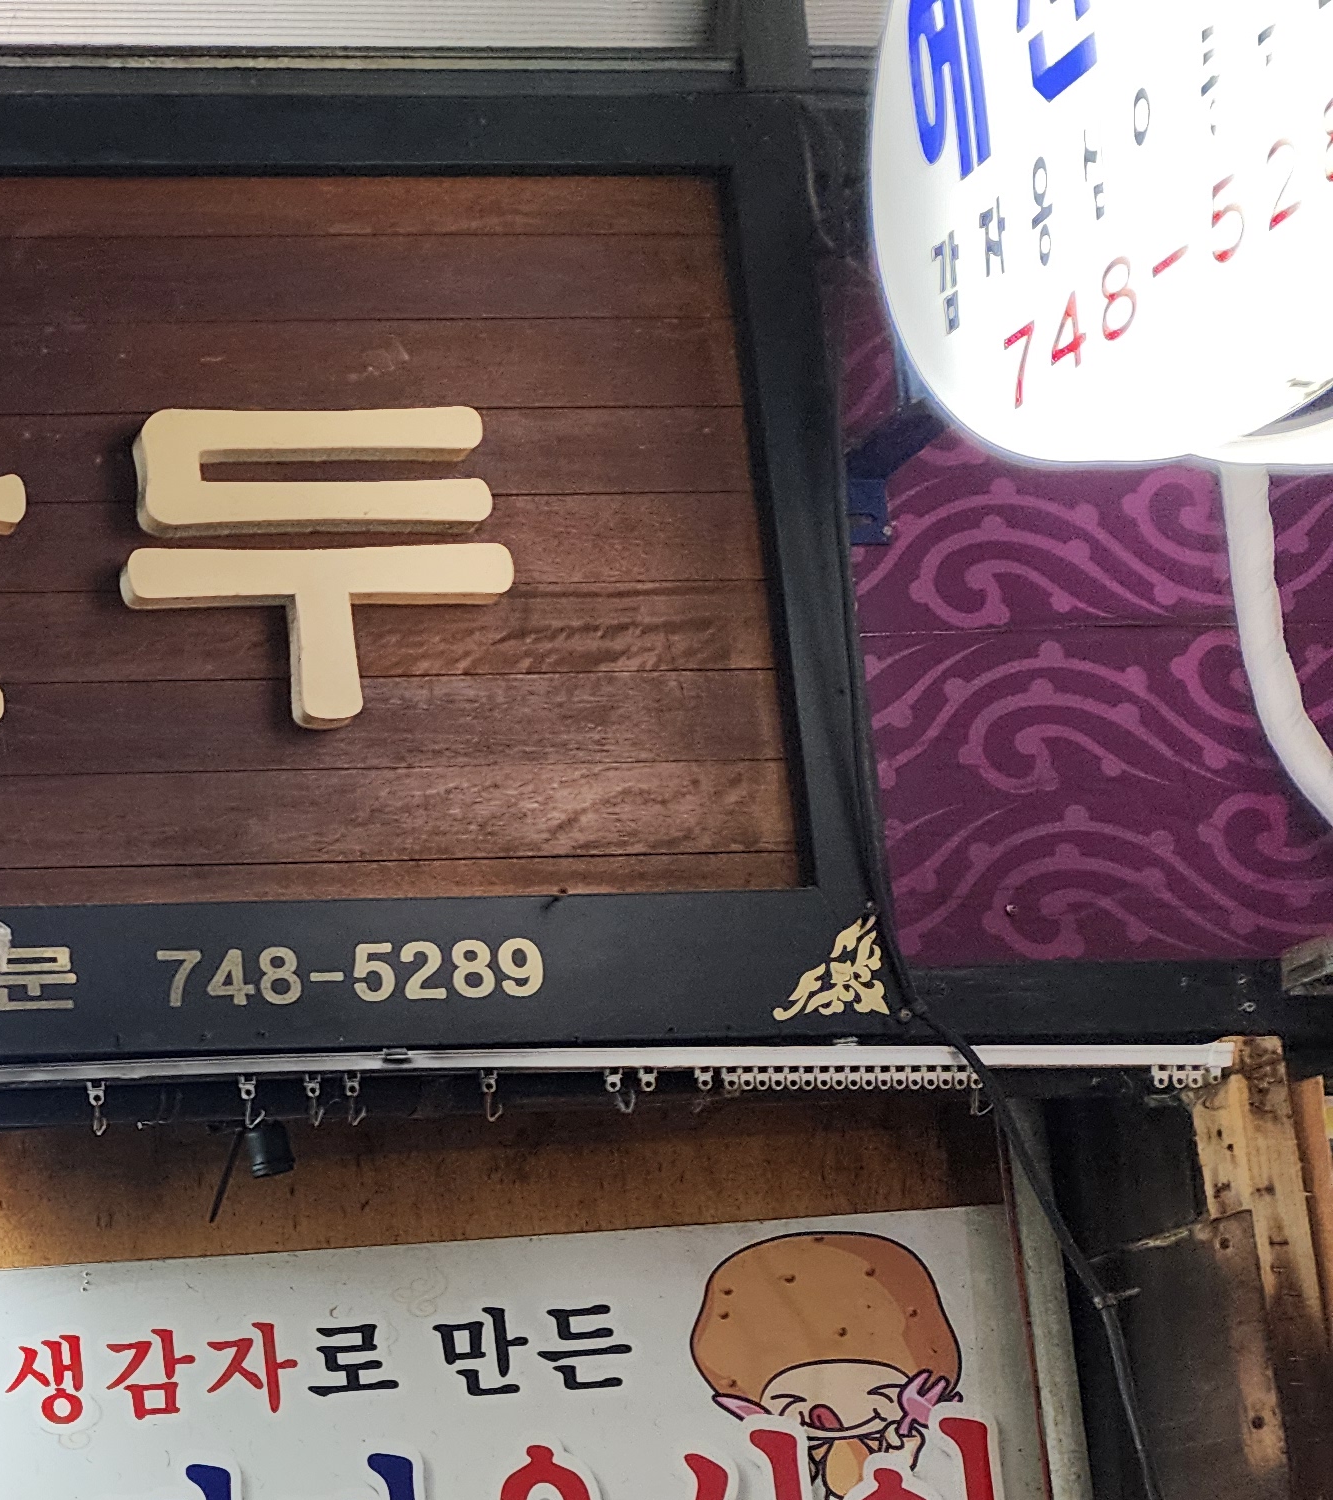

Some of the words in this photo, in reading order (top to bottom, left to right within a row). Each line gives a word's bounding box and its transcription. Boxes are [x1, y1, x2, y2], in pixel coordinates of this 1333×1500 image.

[155, 937, 545, 1010] 748-5289
[4, 1321, 400, 1426] 생감자로
[433, 1303, 633, 1399] 만든
